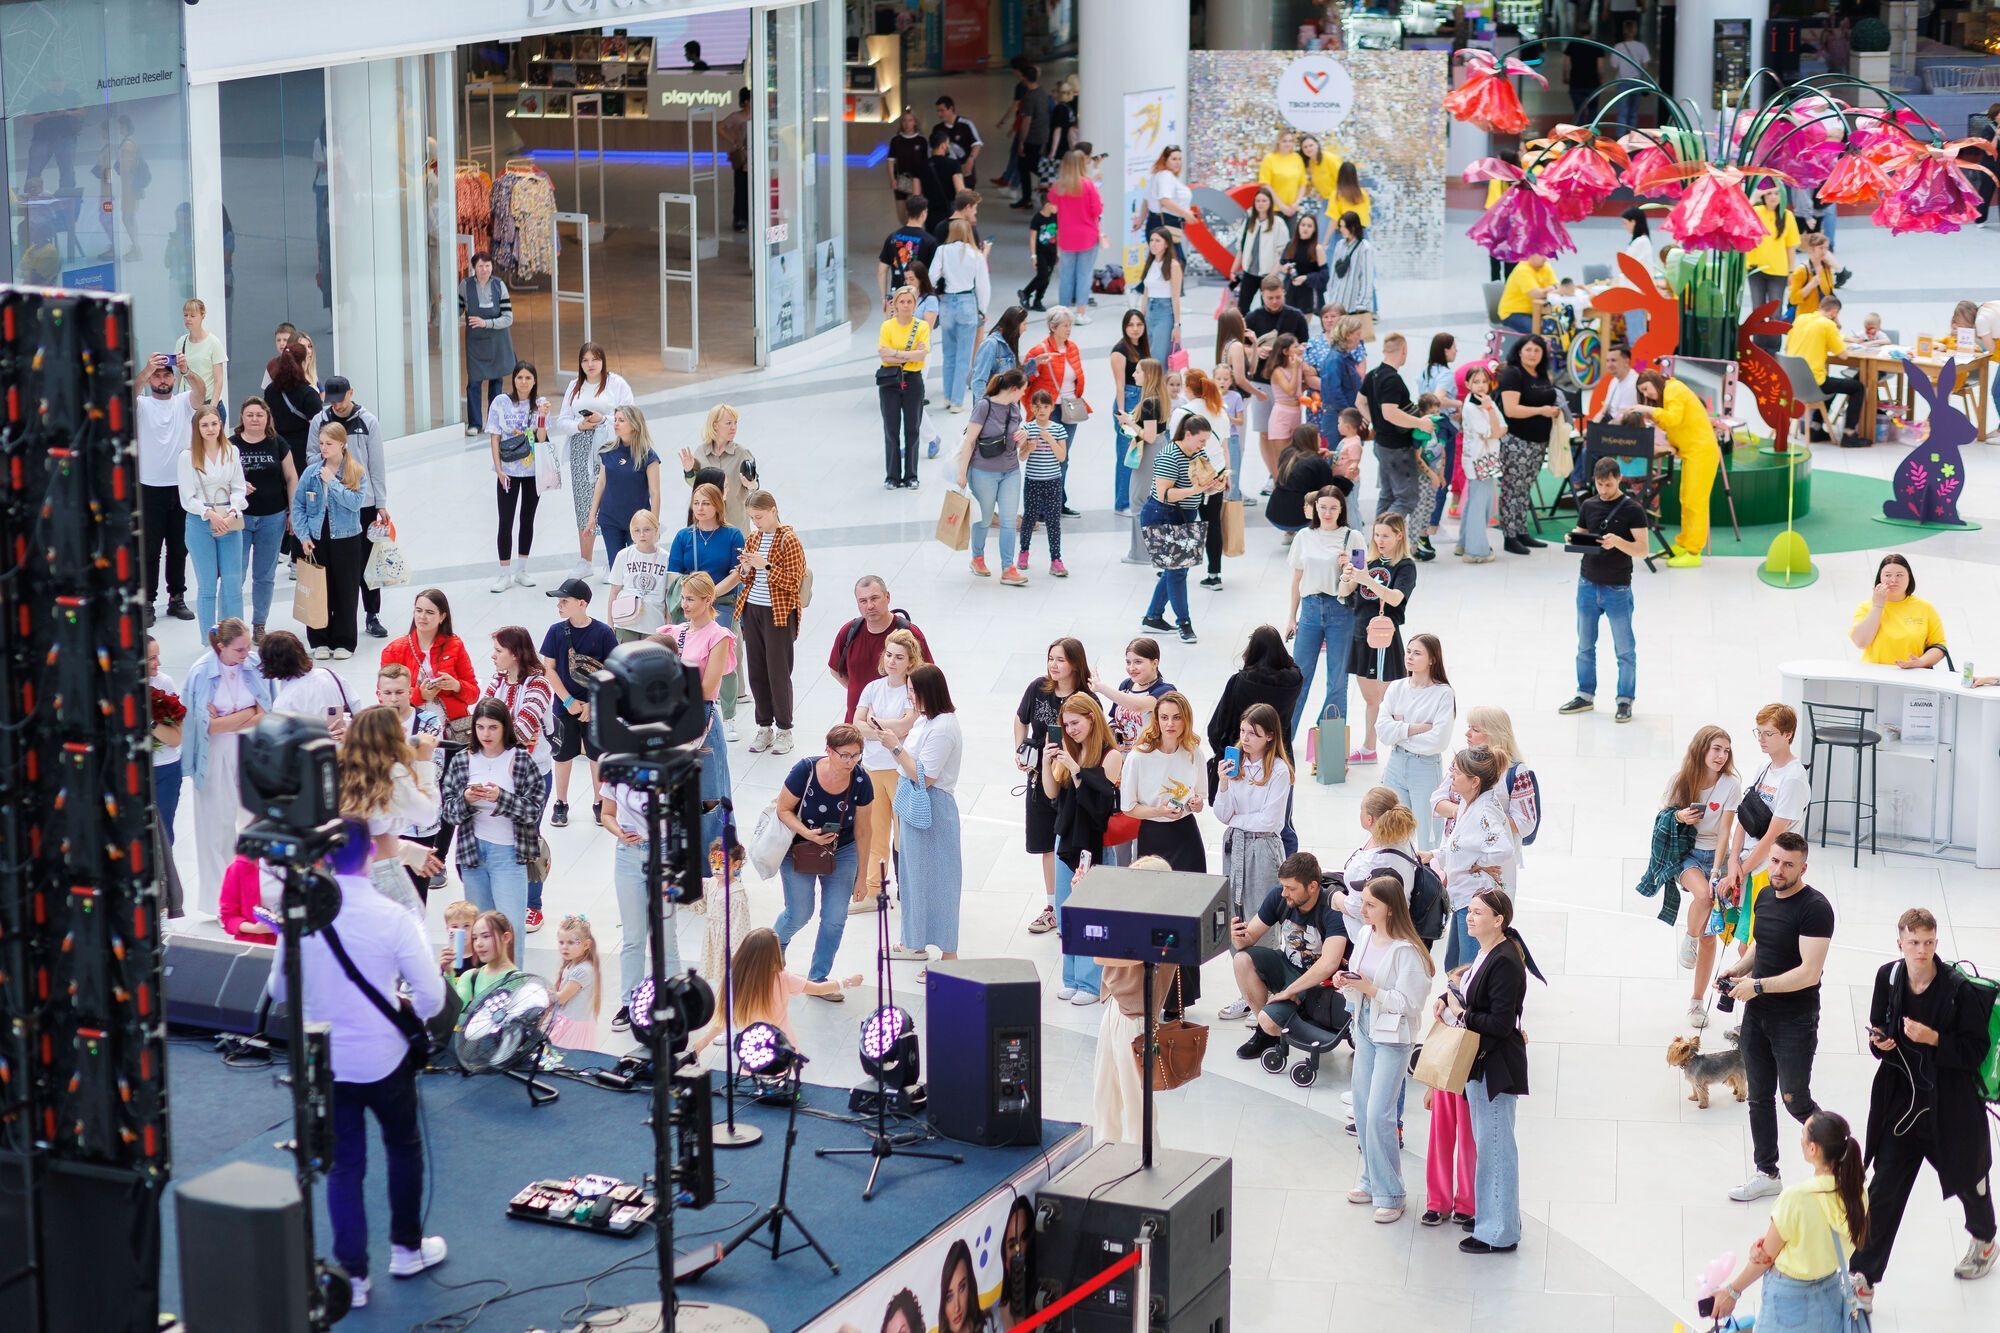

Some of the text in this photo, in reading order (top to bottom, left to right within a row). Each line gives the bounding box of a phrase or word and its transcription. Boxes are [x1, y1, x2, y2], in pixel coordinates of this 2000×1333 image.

[96, 70, 173, 89] Authorized Reseller
[661, 89, 732, 107] playvinyl
[240, 455, 275, 463] ETTER
[626, 561, 666, 576] FAYETTE
[1103, 1240, 1109, 1251] 3
